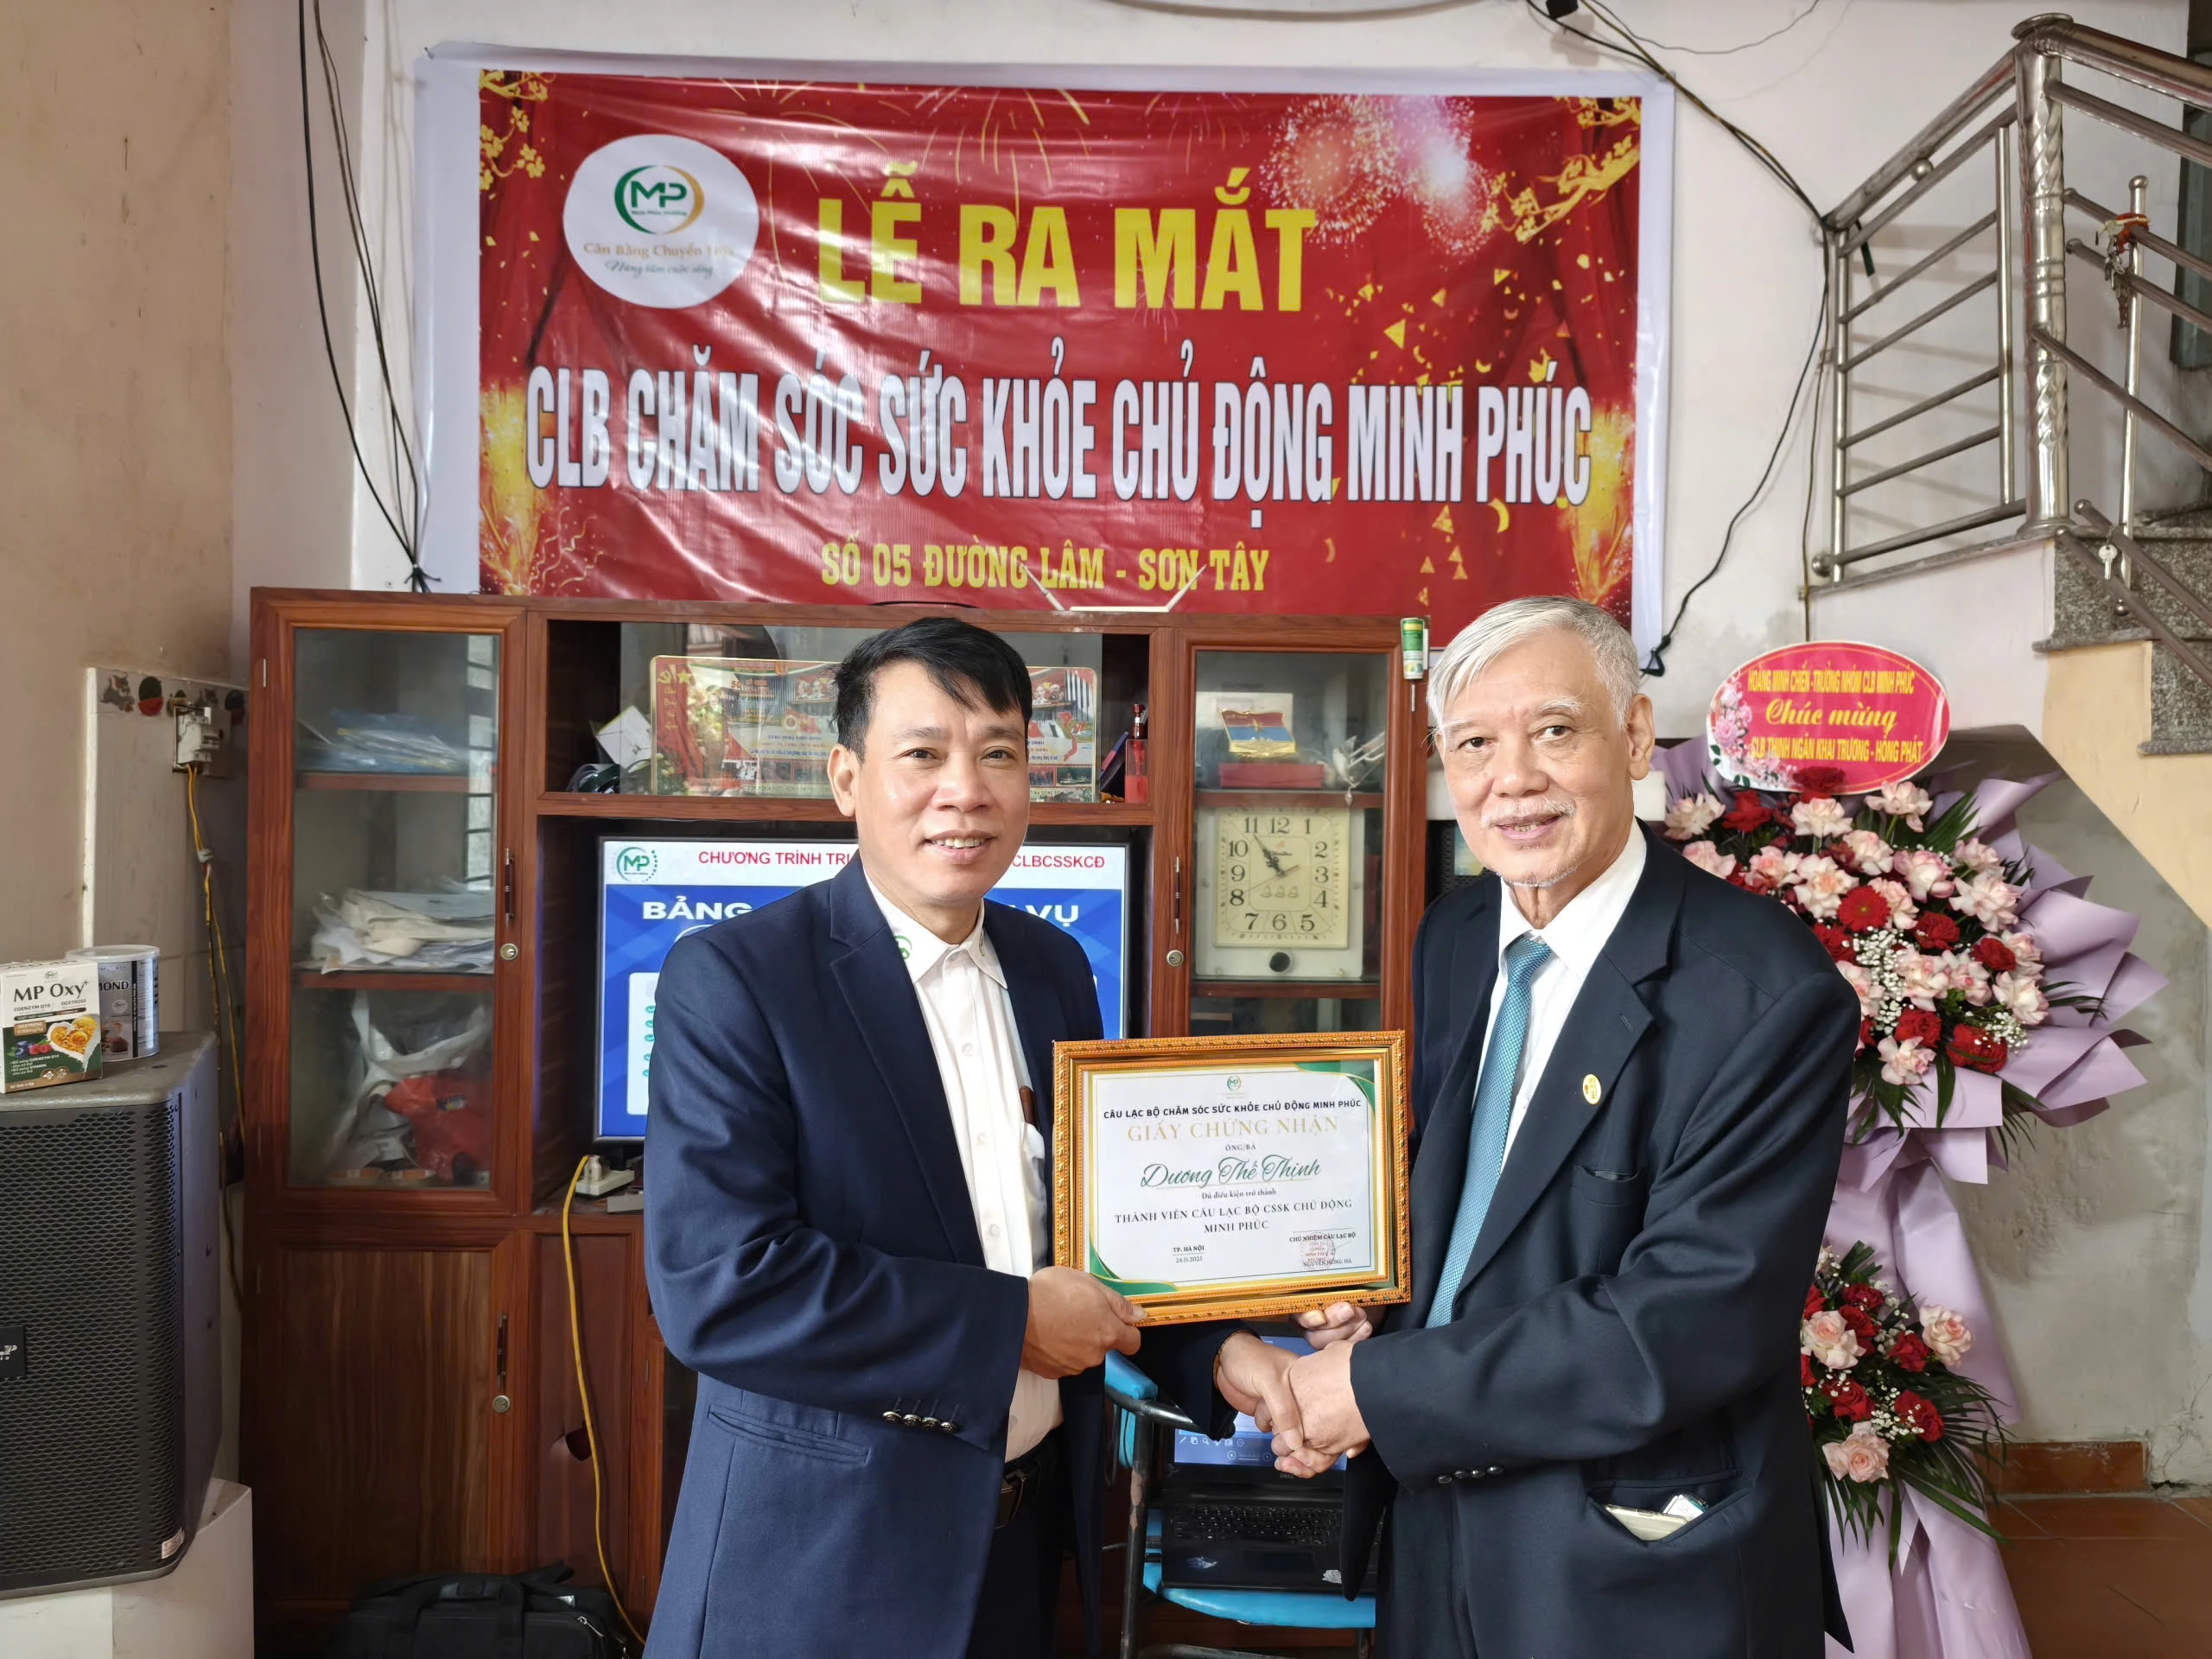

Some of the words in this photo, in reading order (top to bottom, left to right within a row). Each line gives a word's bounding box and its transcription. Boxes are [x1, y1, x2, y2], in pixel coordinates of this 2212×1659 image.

[631, 181, 687, 208] MP
[817, 160, 922, 305] LỄ
[959, 204, 1081, 308] RA
[1114, 167, 1316, 312] MẮT
[525, 365, 610, 490] CLB
[626, 344, 760, 493] CHĂM
[775, 346, 863, 495] SÓC
[878, 349, 968, 498] SỨC
[982, 335, 1097, 500] KHỎE
[1112, 339, 1201, 501] CHỦ
[1212, 356, 1333, 529] ĐỘNG
[1346, 384, 1465, 504] MINH
[1476, 360, 1592, 506] PHÚC
[822, 530, 861, 587] SỐ
[873, 543, 912, 587] 05
[923, 535, 1028, 588] ĐƯỜNG
[1040, 539, 1104, 590] LÂM
[1139, 547, 1199, 591] SƠN
[1209, 540, 1270, 591] TÂY
[1765, 698, 1823, 726] Chúc
[1828, 701, 1898, 734] mừng
[1816, 737, 1834, 760] KHAI
[1900, 734, 1924, 763] PHÁT
[1244, 817, 1258, 834] 11
[1270, 817, 1291, 835] 12
[1304, 817, 1311, 835] 1
[698, 851, 770, 865] CHƯƠNG
[775, 849, 821, 865] TRÌNH
[1228, 840, 1249, 857] 10
[1315, 842, 1328, 859] 2
[624, 855, 650, 871] MP
[1013, 855, 1105, 868] CLBCSSKCĐ
[1230, 865, 1245, 882] 9
[1315, 866, 1329, 883] 3
[643, 895, 753, 920] BẢNG
[1230, 889, 1244, 906] 8
[1313, 890, 1328, 907] 4
[1244, 912, 1259, 931] 7
[1272, 913, 1287, 931] 6
[1300, 914, 1315, 931] 5
[14, 986, 44, 1002] MP
[1103, 1109, 1122, 1119] CÂU
[1126, 1109, 1143, 1119] LẠC
[1147, 1106, 1160, 1118] BỘ
[1163, 1106, 1189, 1116] CHĂM
[1192, 1105, 1209, 1115] SÓC
[1212, 1103, 1231, 1113] SỨC
[1235, 1101, 1260, 1112] KHỎE
[1263, 1100, 1281, 1111] CHỦ
[1285, 1100, 1310, 1111] ĐỘNG
[1313, 1101, 1335, 1109] MINH
[1338, 1098, 1361, 1108] PHÚC
[1128, 1120, 1182, 1141] GIẤY
[1190, 1117, 1268, 1139] CHỨNG
[1278, 1114, 1338, 1136] NHẬN
[1141, 1163, 1212, 1188] Dương
[1217, 1156, 1258, 1185] Thế
[1262, 1154, 1321, 1182] Thịnh
[1230, 1189, 1244, 1198] kiện
[1115, 1211, 1157, 1224] THÀNH
[1161, 1209, 1188, 1220] VIÊN
[1192, 1207, 1215, 1218] CÂU
[1219, 1206, 1242, 1217] LẠC
[1245, 1204, 1260, 1216] BỘ
[1263, 1204, 1290, 1213] CSSK
[1294, 1200, 1317, 1211] CHỦ
[1204, 1223, 1235, 1233] MINH
[1238, 1219, 1269, 1231] PHÚC
